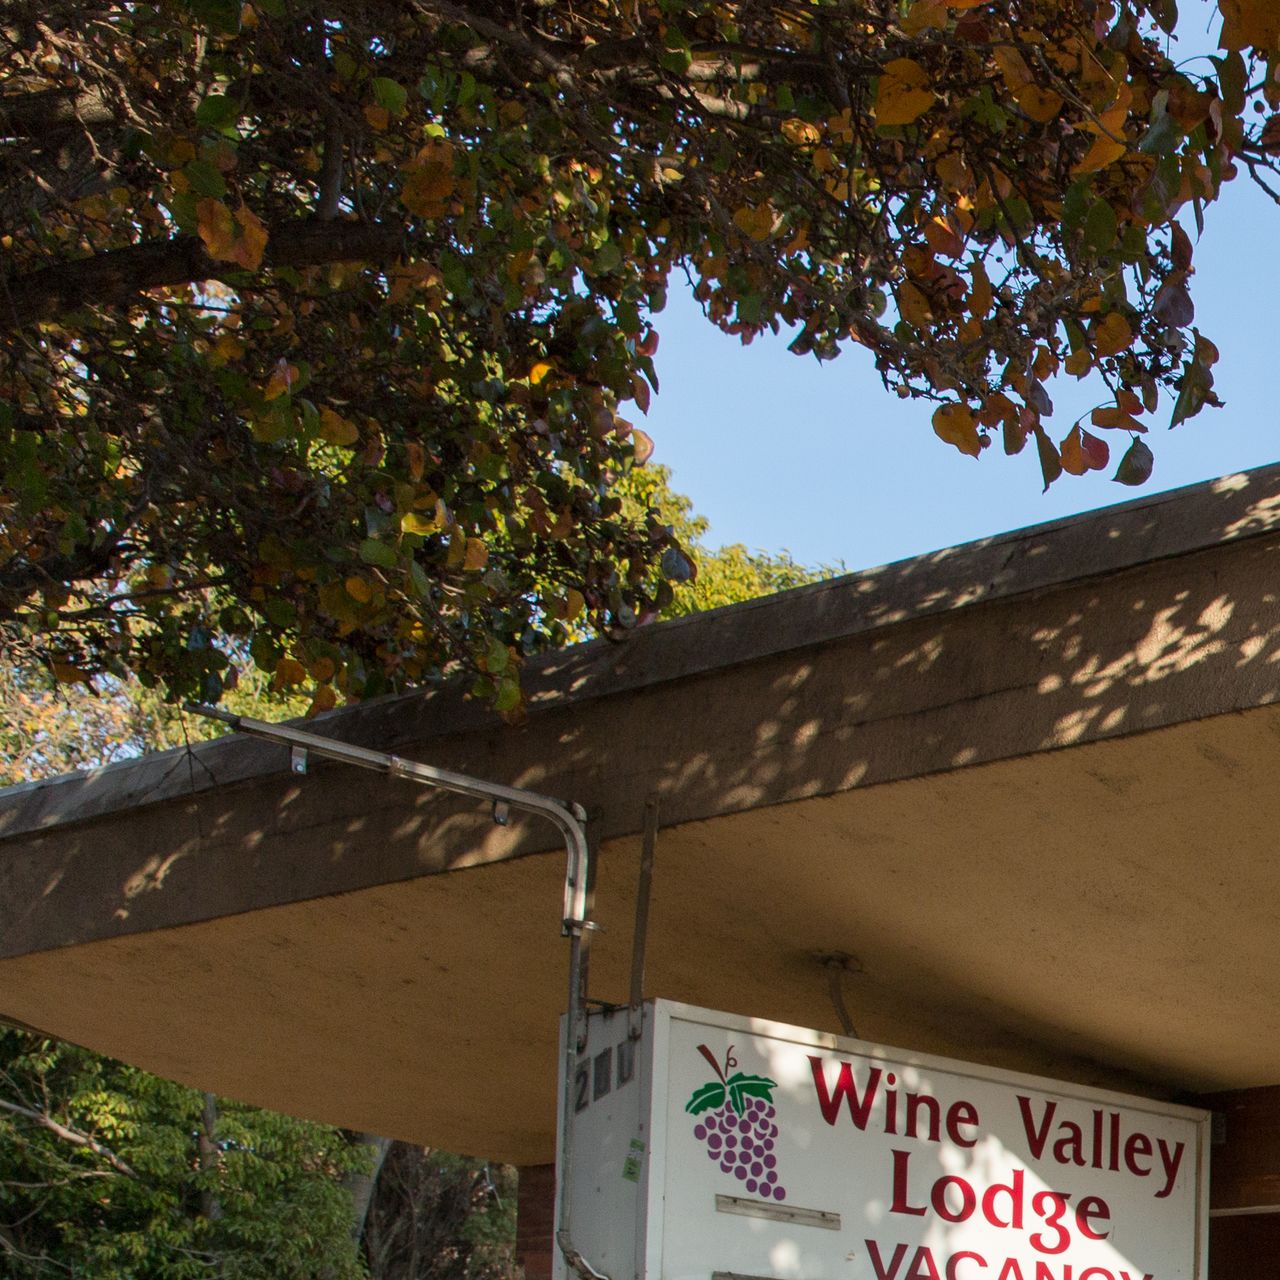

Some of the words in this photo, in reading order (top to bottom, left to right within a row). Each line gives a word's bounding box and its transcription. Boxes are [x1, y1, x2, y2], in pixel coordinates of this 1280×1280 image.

[806, 1053, 980, 1148] Wine
[1015, 1094, 1186, 1199] Valley
[889, 1148, 1112, 1254] Lodge
